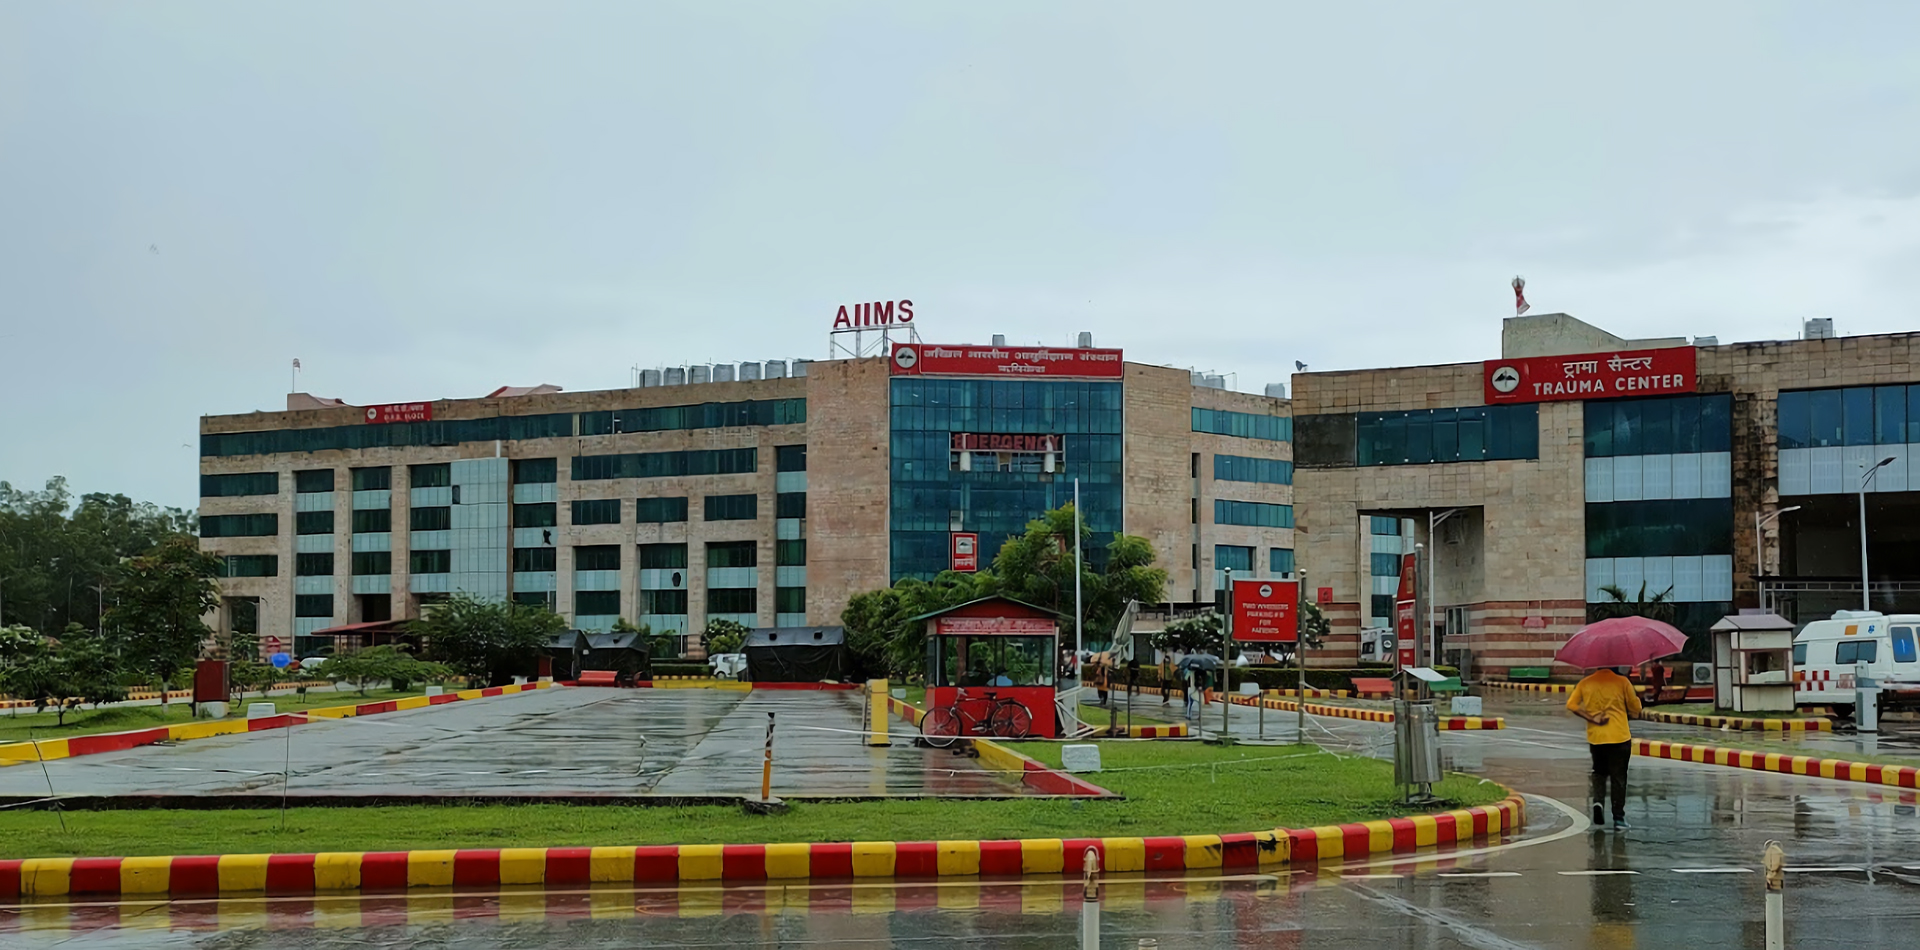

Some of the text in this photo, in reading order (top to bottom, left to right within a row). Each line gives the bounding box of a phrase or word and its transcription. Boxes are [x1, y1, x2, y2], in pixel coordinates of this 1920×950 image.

[833, 299, 914, 328] AIIMS
[968, 348, 1009, 359] भारतीय
[1563, 354, 1652, 378] ट्रामा सैन्टर
[1533, 374, 1684, 396] TRAUMA CENTER
[954, 434, 1060, 450] EMERGENCY
